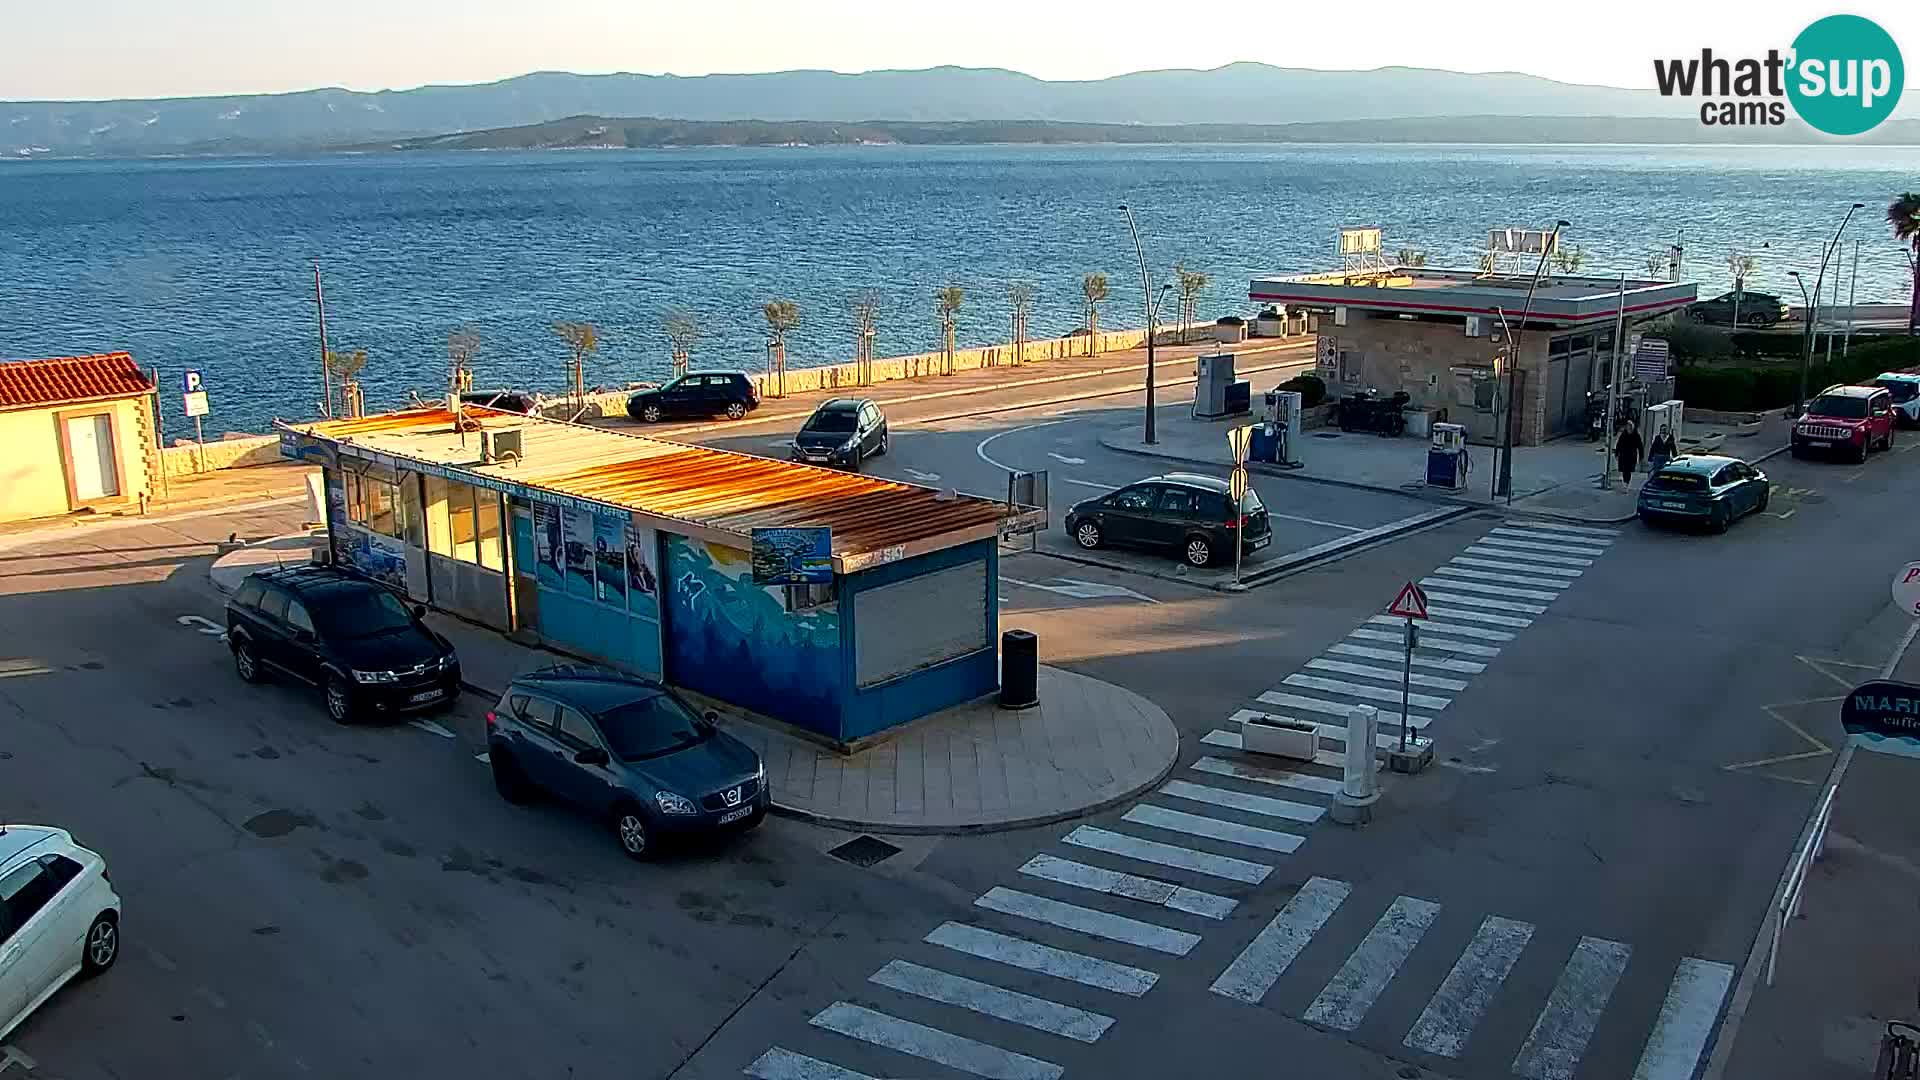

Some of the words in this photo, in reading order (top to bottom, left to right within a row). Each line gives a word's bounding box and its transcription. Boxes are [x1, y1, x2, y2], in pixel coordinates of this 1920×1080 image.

[187, 373, 200, 391] P
[543, 493, 574, 509] STATION
[576, 500, 601, 513] TICKET
[602, 506, 630, 520] OFFICE
